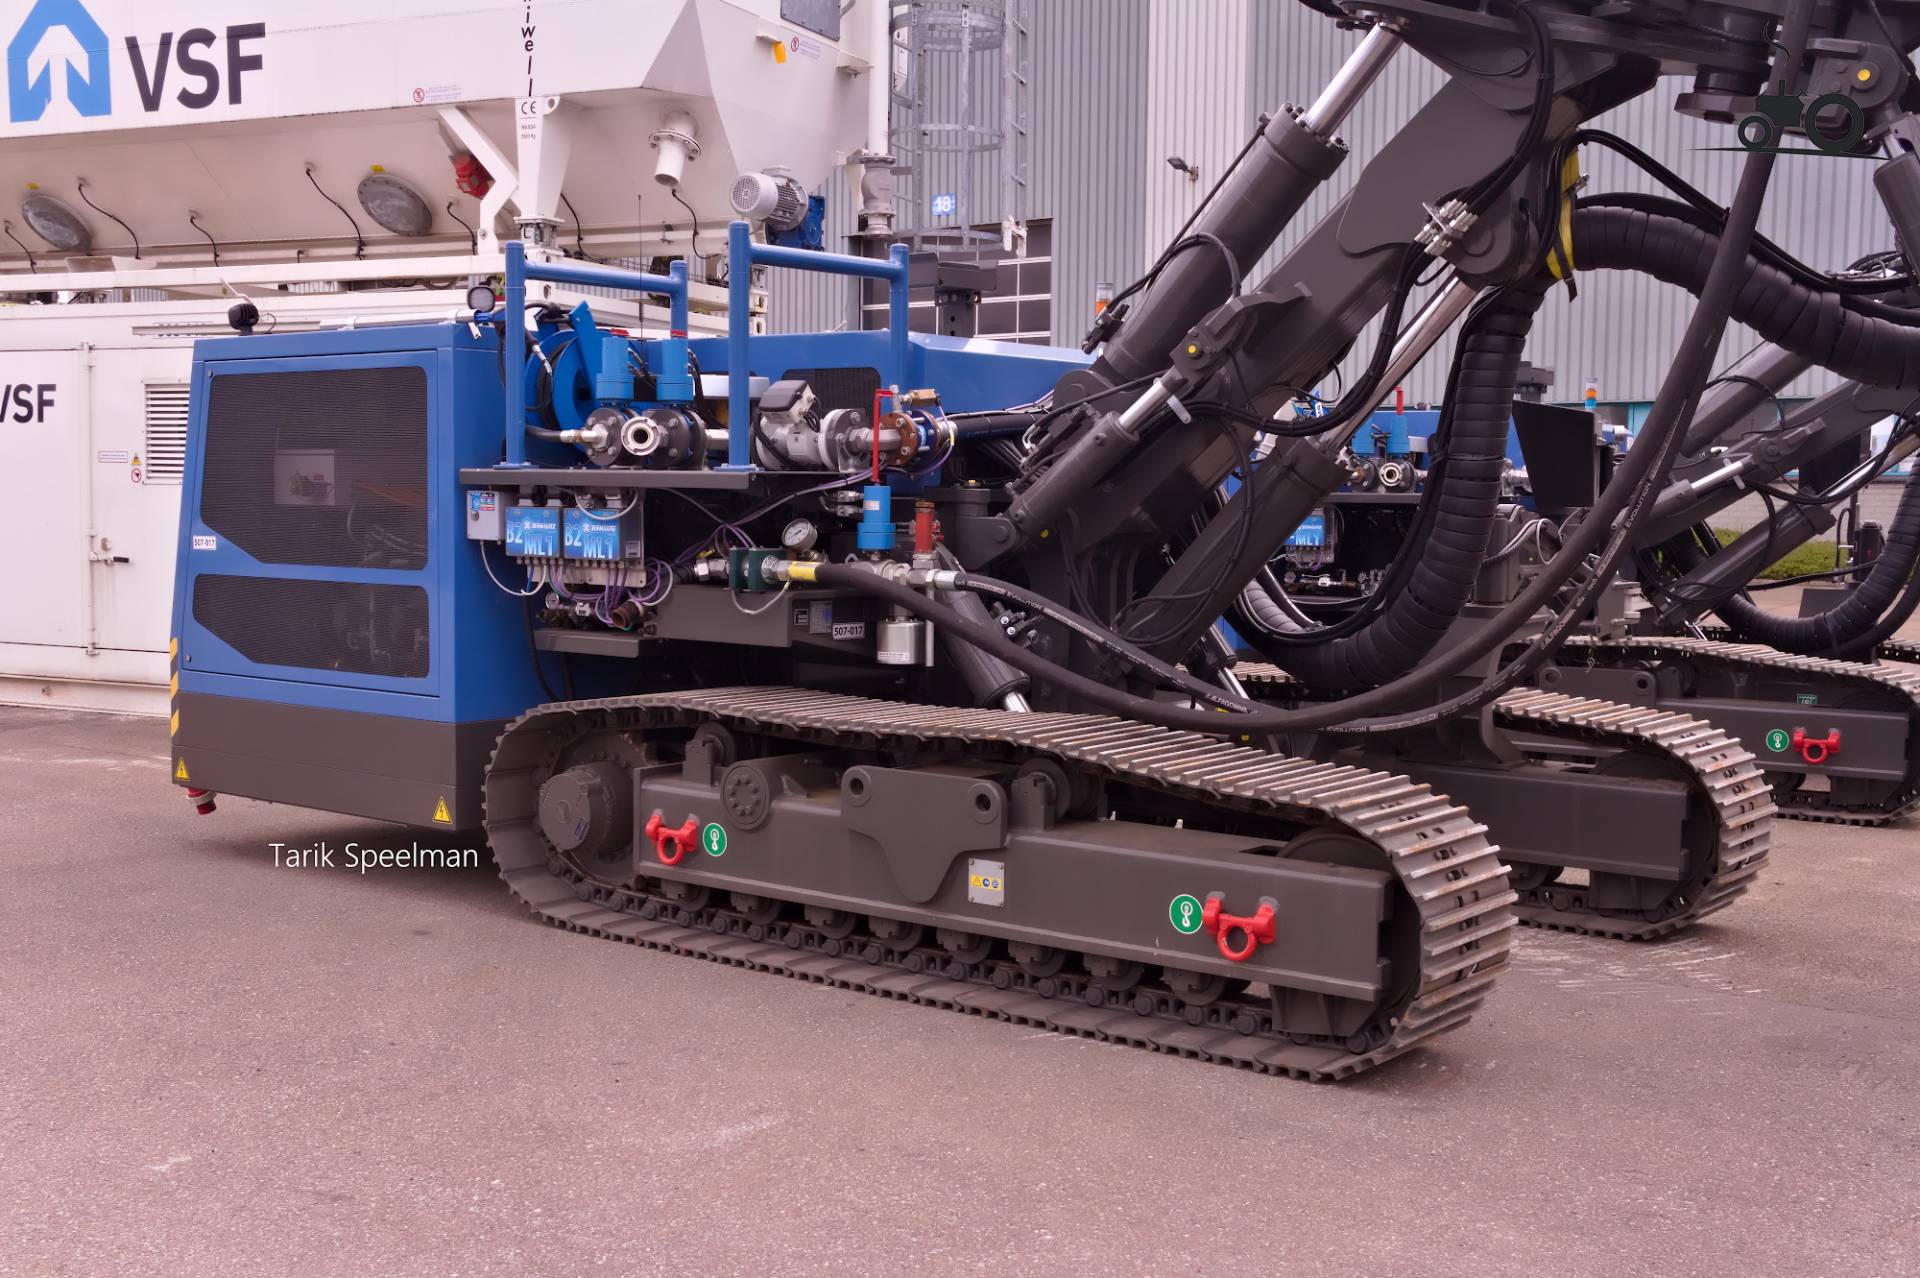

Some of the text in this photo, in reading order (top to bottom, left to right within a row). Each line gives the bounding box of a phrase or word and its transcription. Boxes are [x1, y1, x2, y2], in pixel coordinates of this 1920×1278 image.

[521, 0, 536, 97] iwell
[124, 22, 266, 112] VSF
[524, 534, 553, 556] ML1
[564, 523, 582, 547] B2
[583, 537, 613, 559] ML1
[834, 625, 863, 637] 507-017
